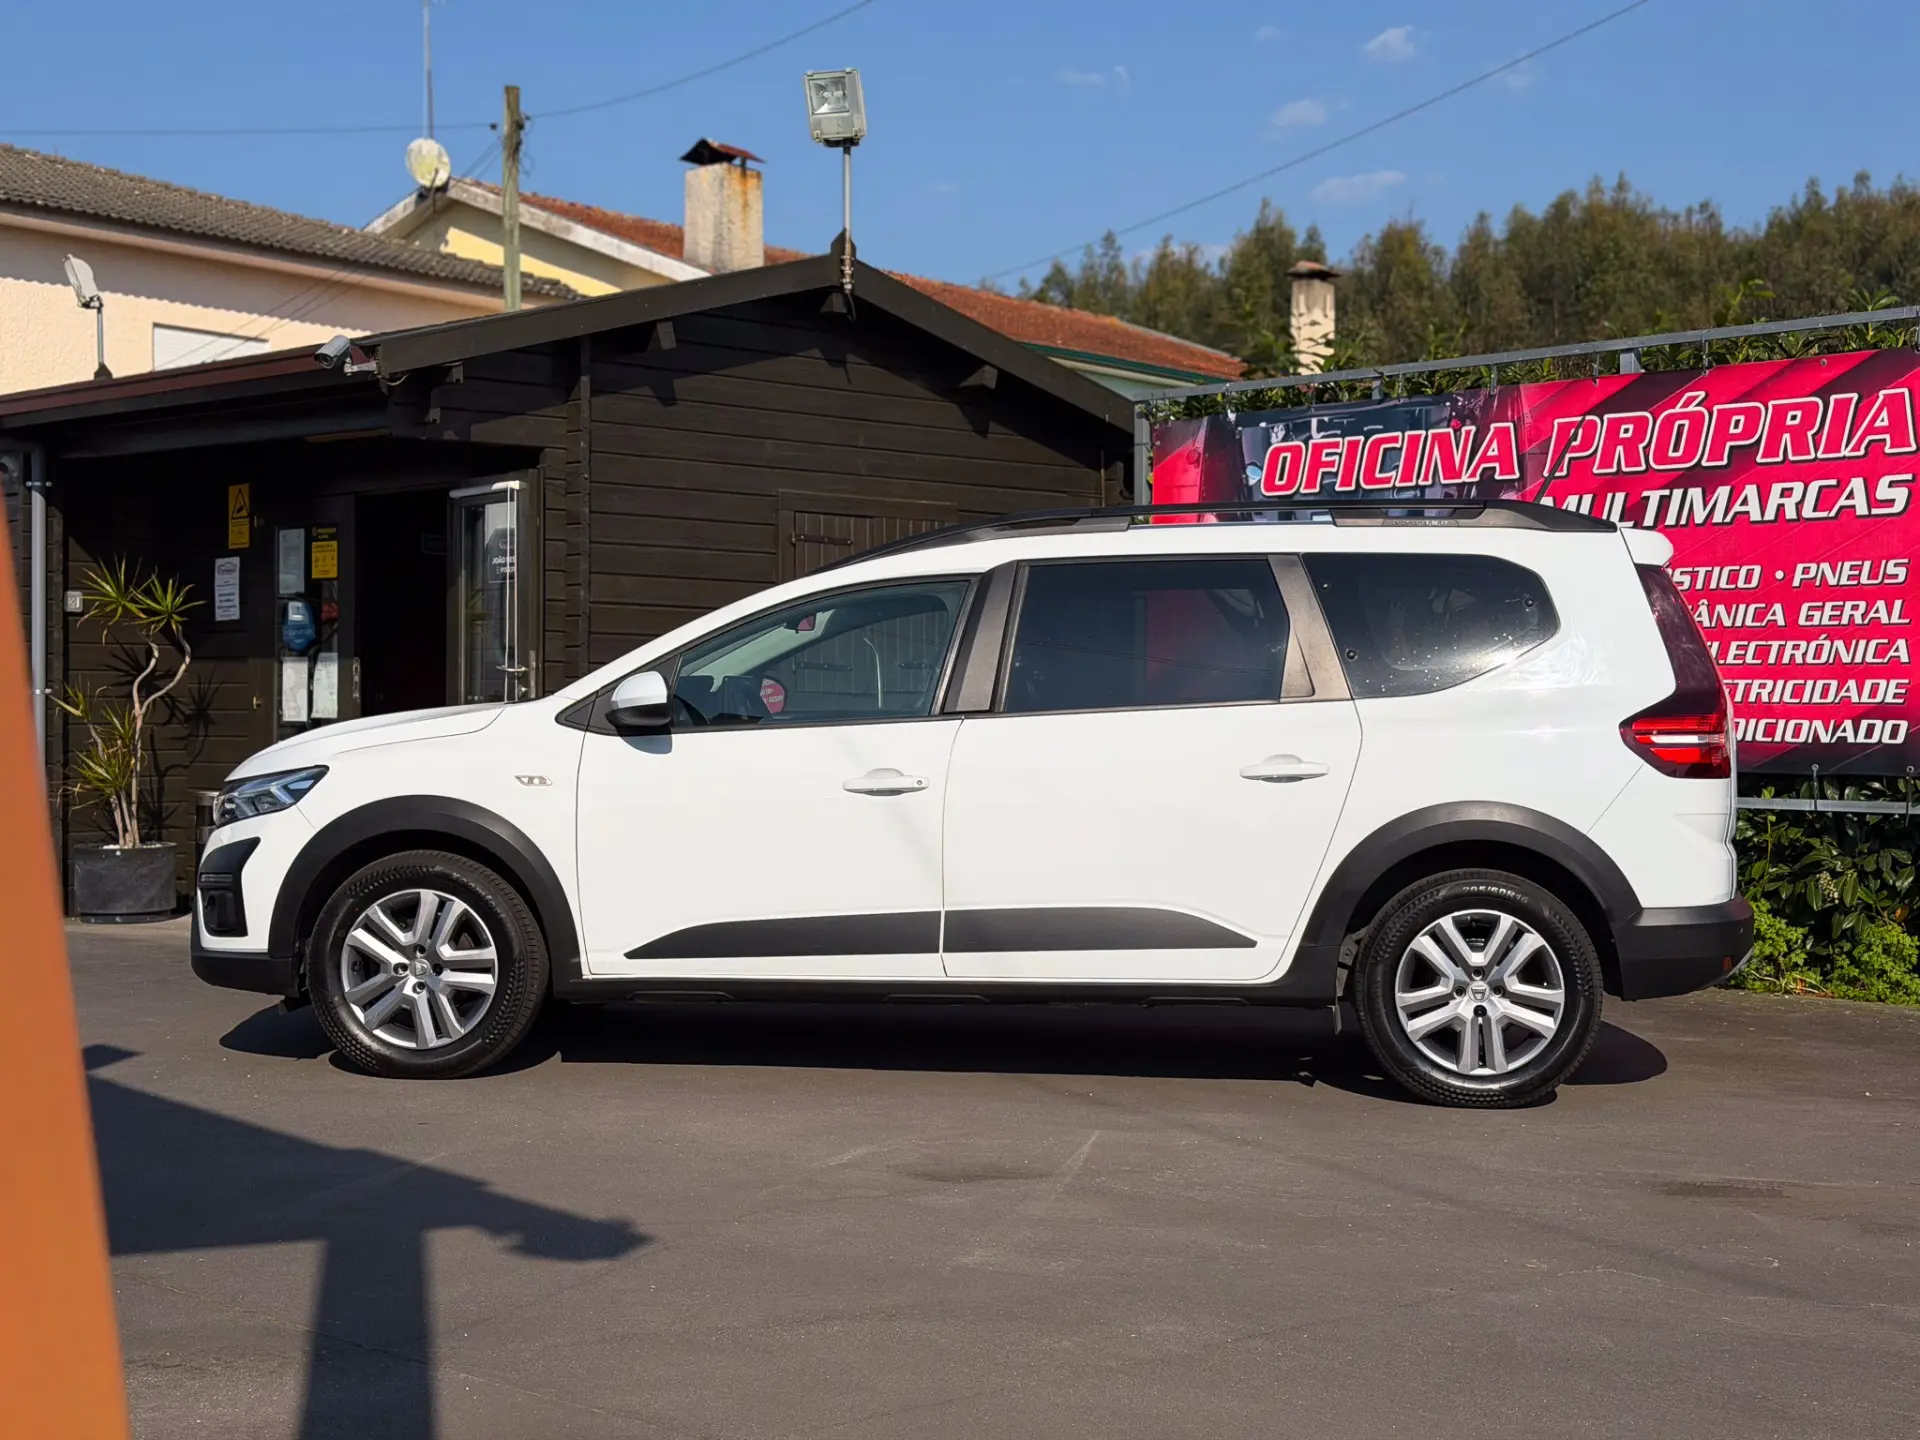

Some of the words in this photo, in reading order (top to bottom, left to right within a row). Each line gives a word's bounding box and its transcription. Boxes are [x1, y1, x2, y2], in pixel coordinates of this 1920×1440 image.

[1261, 422, 1520, 496] OFICINA
[1544, 388, 1917, 477] PRÓPRIA
[1665, 563, 1761, 591] STICO
[1792, 559, 1910, 588] PNEUS
[1688, 599, 1787, 628] ÂNICA
[1797, 600, 1910, 627] GERAL
[1706, 634, 1911, 665] LECTRÓNICA
[1722, 679, 1910, 703] TRICIDADE
